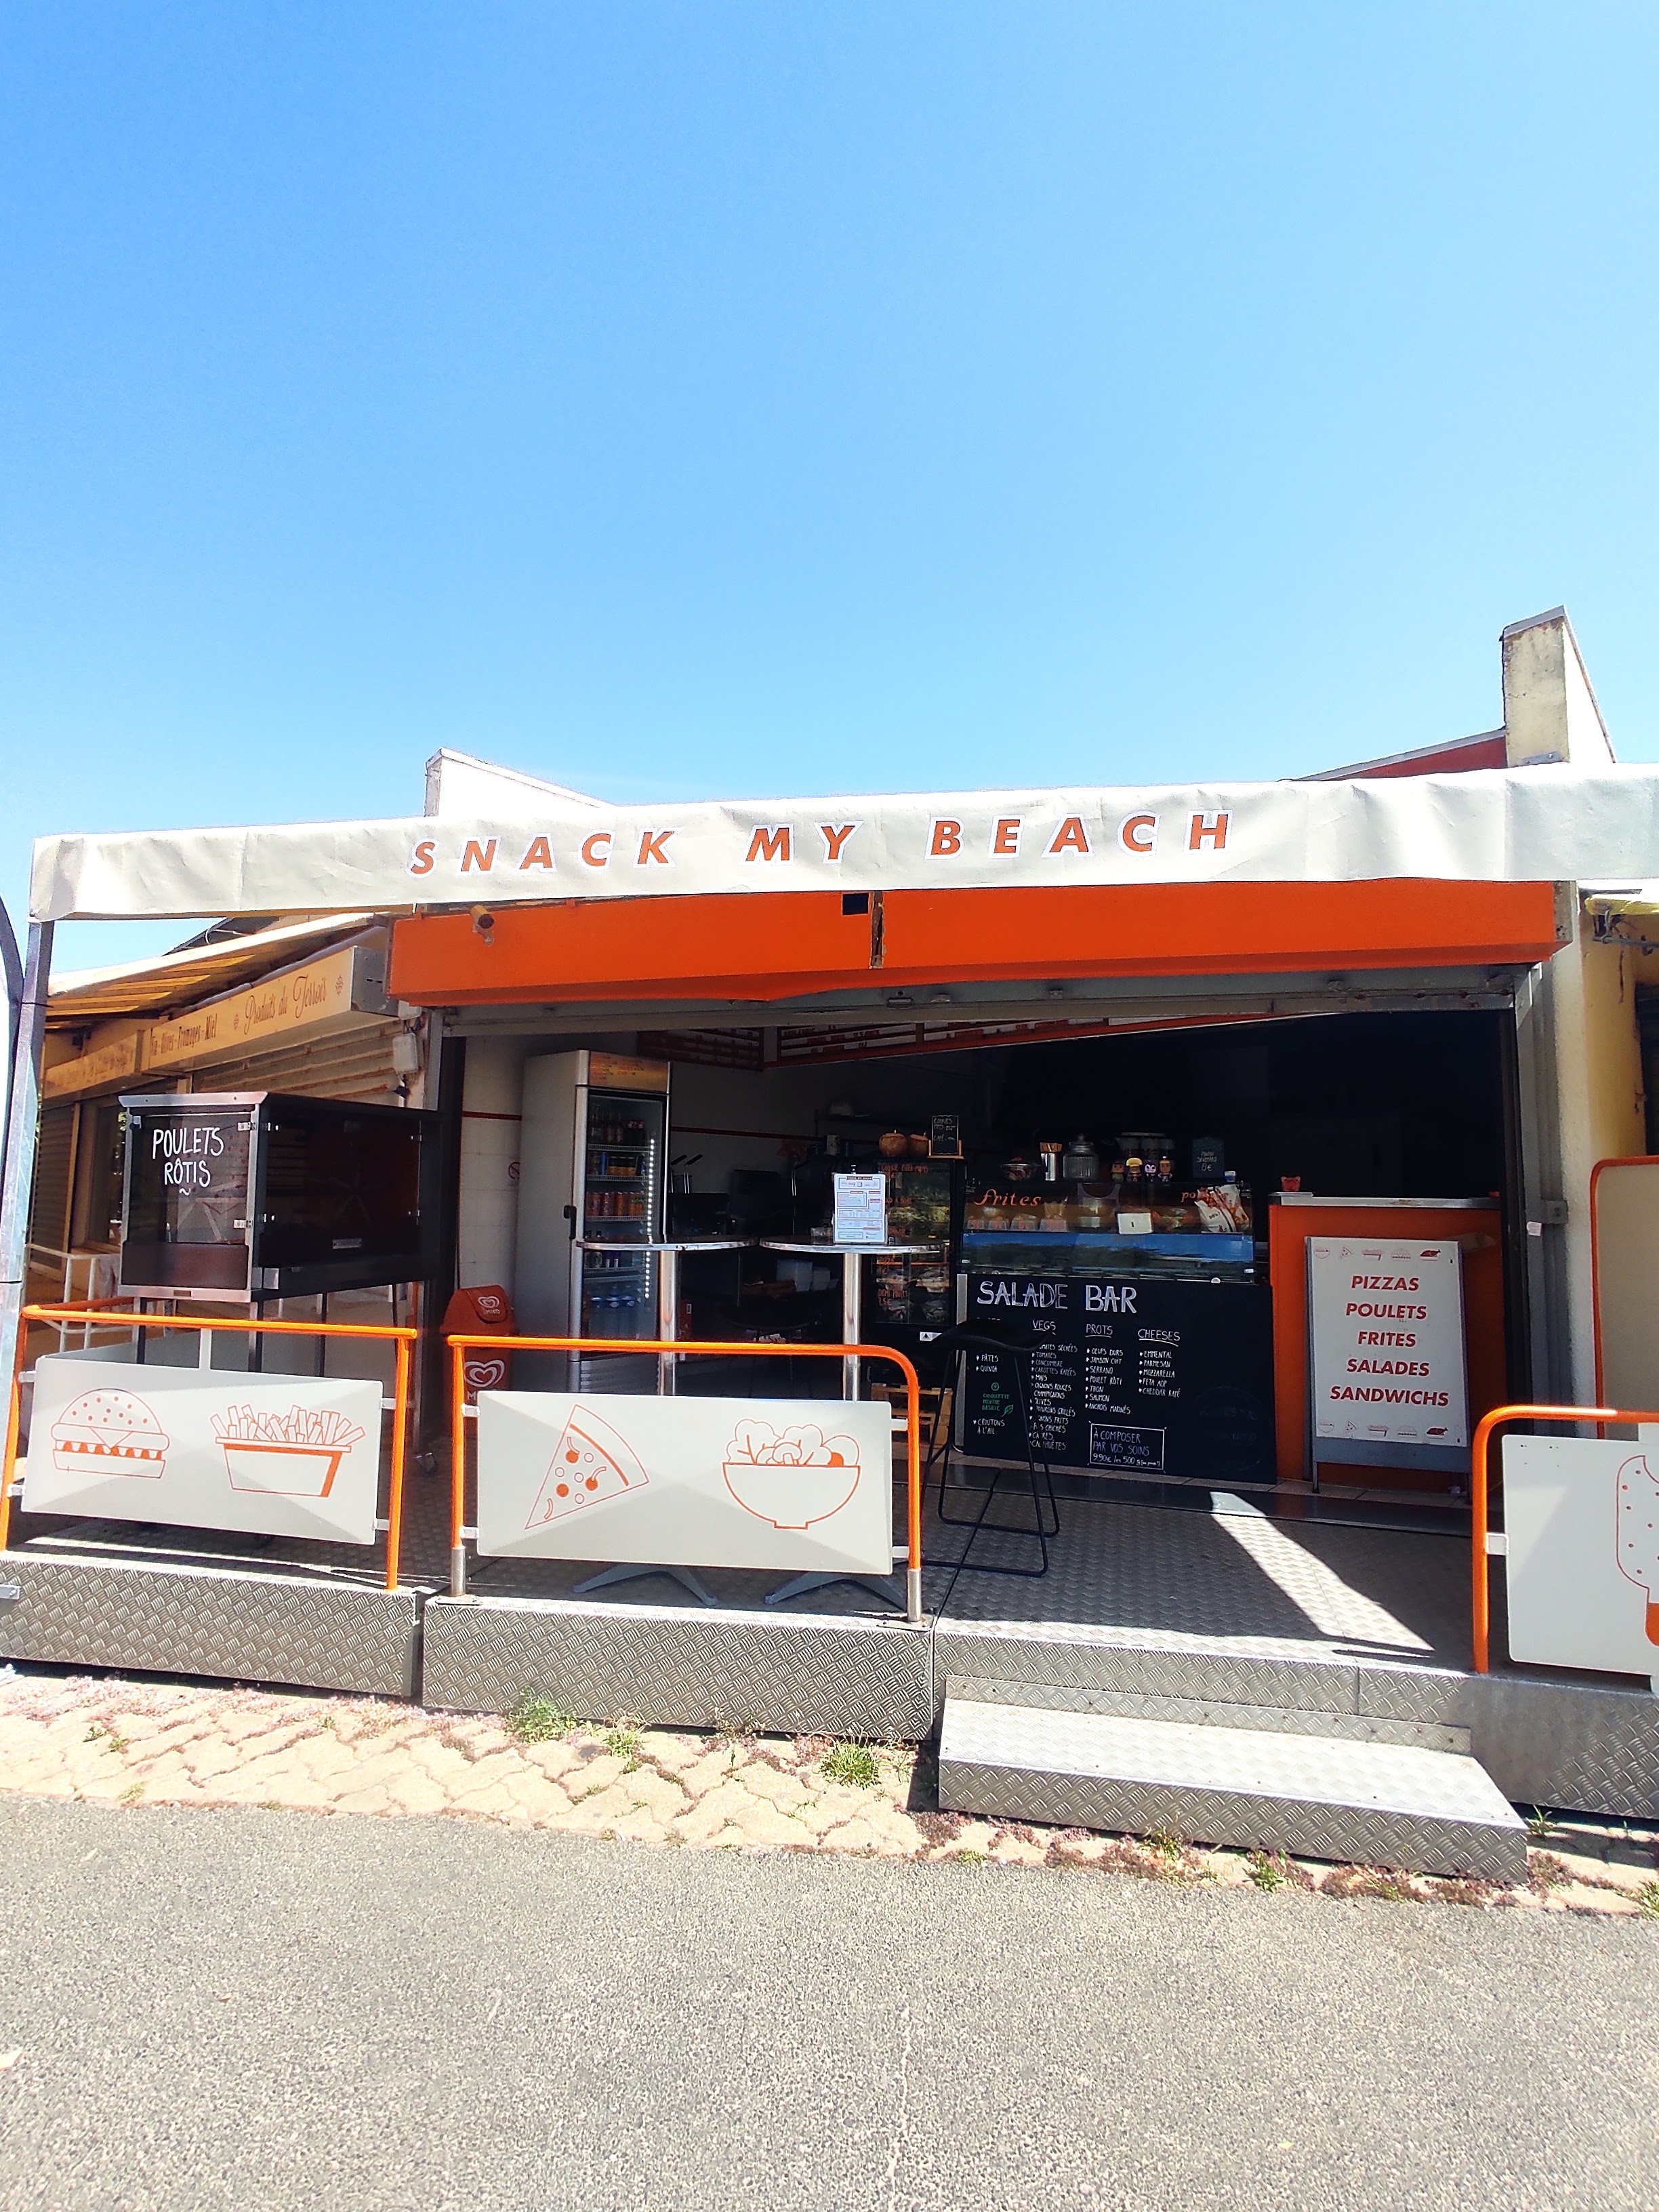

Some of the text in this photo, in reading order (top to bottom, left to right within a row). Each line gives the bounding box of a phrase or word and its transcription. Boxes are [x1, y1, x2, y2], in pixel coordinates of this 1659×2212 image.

[410, 813, 1228, 875] SNACK MY BEACH
[278, 985, 287, 1016] du
[152, 1126, 224, 1160] POULETS
[164, 1158, 211, 1187] RÔTIS
[1201, 1162, 1213, 1172] 8€
[973, 1189, 1042, 1207] frites
[1351, 1275, 1420, 1292] PIZZAS
[976, 1280, 1138, 1314] SALADE BAR
[1345, 1302, 1427, 1319] POULETS
[1032, 1319, 1057, 1331] VEGS
[1085, 1324, 1113, 1336] PROTS
[1137, 1328, 1181, 1342] CHEESES
[1357, 1331, 1416, 1347] FRITES
[981, 1353, 999, 1363] PÂTES
[1143, 1351, 1172, 1359] EMMENTAL
[1035, 1359, 1063, 1368] CONCOMBRE
[1143, 1359, 1171, 1368] PARMESAN
[1346, 1358, 1429, 1376] SALADES
[1034, 1366, 1059, 1375] CAROTTES
[1089, 1366, 1113, 1374] SERRANO
[1143, 1369, 1175, 1378] MOZZARELLA
[1089, 1375, 1107, 1384] POULET
[1143, 1378, 1168, 1388] FETA AOP
[1054, 1383, 1072, 1392] ROUGES
[1142, 1388, 1166, 1397] CHEDDAR
[1088, 1394, 1110, 1402] SAUMON
[1330, 1385, 1450, 1407] SANDWICHS
[1088, 1402, 1107, 1412] ANCHOIS
[1054, 1416, 1069, 1425] FRITS
[1100, 1430, 1141, 1444] COMPOSER
[1092, 1441, 1150, 1457] PAR VOS SOINS
[1122, 1456, 1135, 1465] 500
